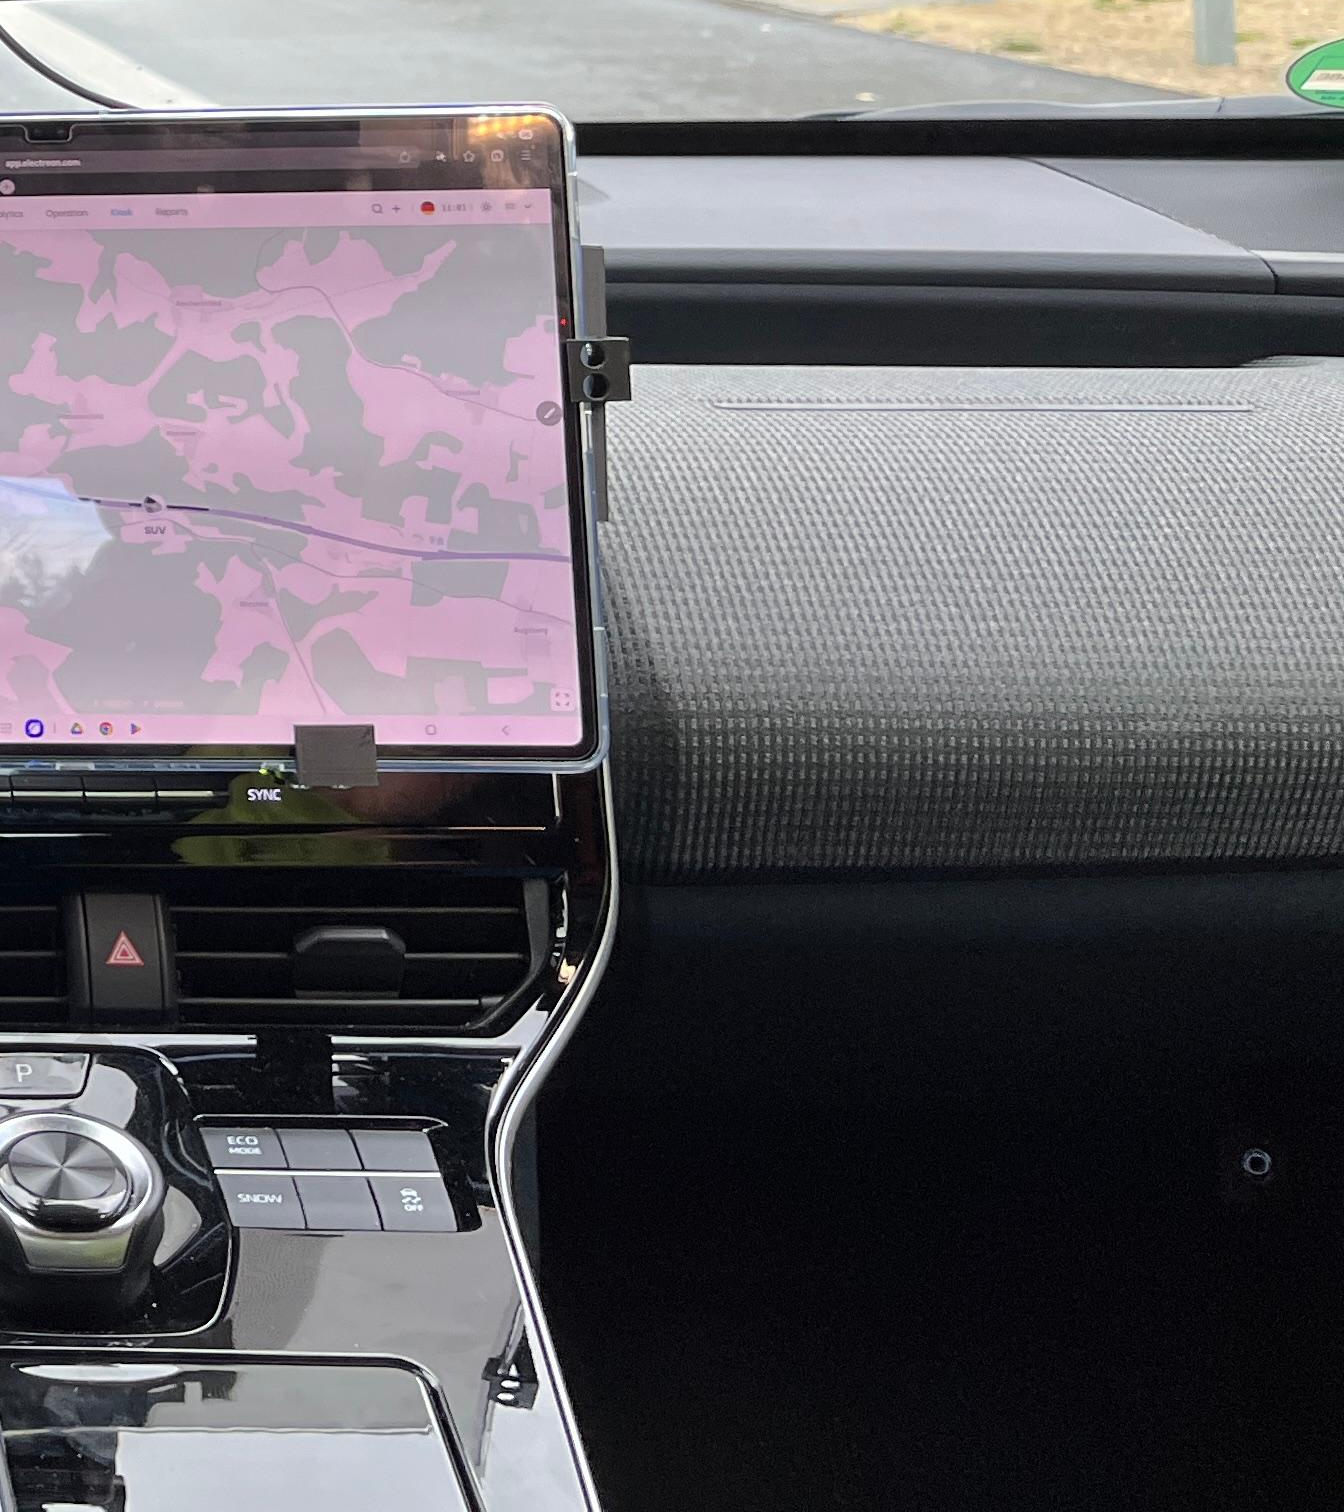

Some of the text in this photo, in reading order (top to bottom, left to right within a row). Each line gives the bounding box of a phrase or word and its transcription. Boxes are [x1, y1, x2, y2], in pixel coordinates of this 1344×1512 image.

[45, 208, 88, 219] Operation
[155, 206, 188, 218] Reports
[144, 525, 167, 536] SUV
[247, 788, 282, 801] SYNC
[15, 1063, 33, 1083] P
[226, 1135, 259, 1146] ECO
[228, 1146, 262, 1156] MODE
[237, 1193, 282, 1204] SNOW
[403, 1204, 424, 1212] OFF
